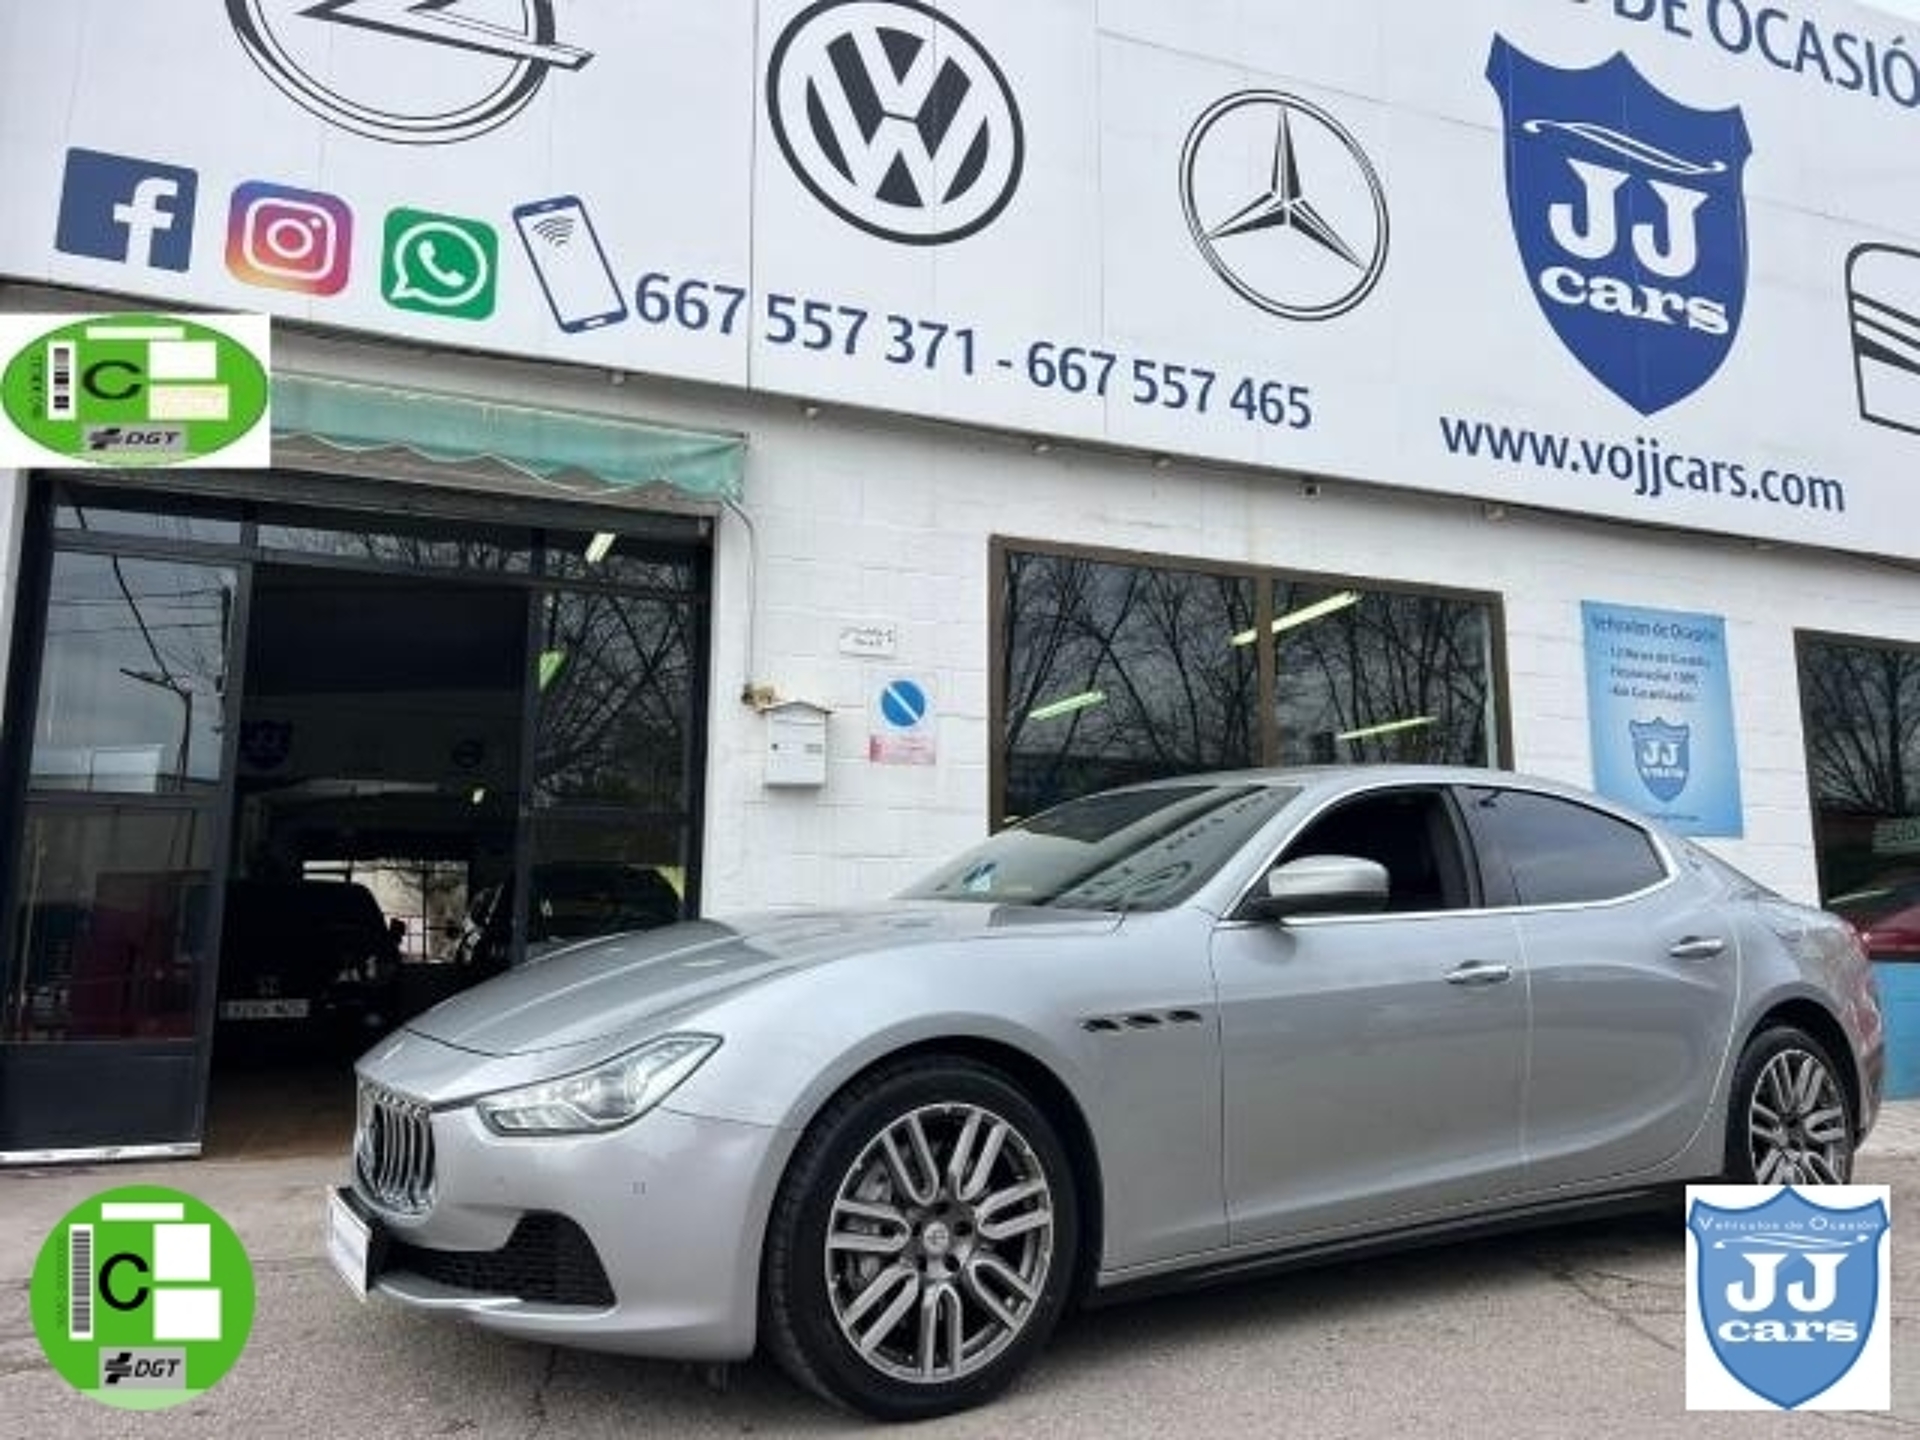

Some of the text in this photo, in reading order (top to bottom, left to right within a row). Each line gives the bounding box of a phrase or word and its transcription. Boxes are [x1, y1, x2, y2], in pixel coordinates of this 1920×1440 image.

[1548, 158, 1709, 278] JJ
[1538, 265, 1730, 336] cars
[635, 272, 746, 334] 667
[764, 293, 868, 355] 557
[884, 314, 975, 375] 371
[1026, 341, 1117, 397] 667
[1132, 359, 1216, 413] 557
[1229, 376, 1312, 429] 465
[1440, 416, 1846, 512] www.vojjcars.com
[1643, 740, 1680, 765] JJ
